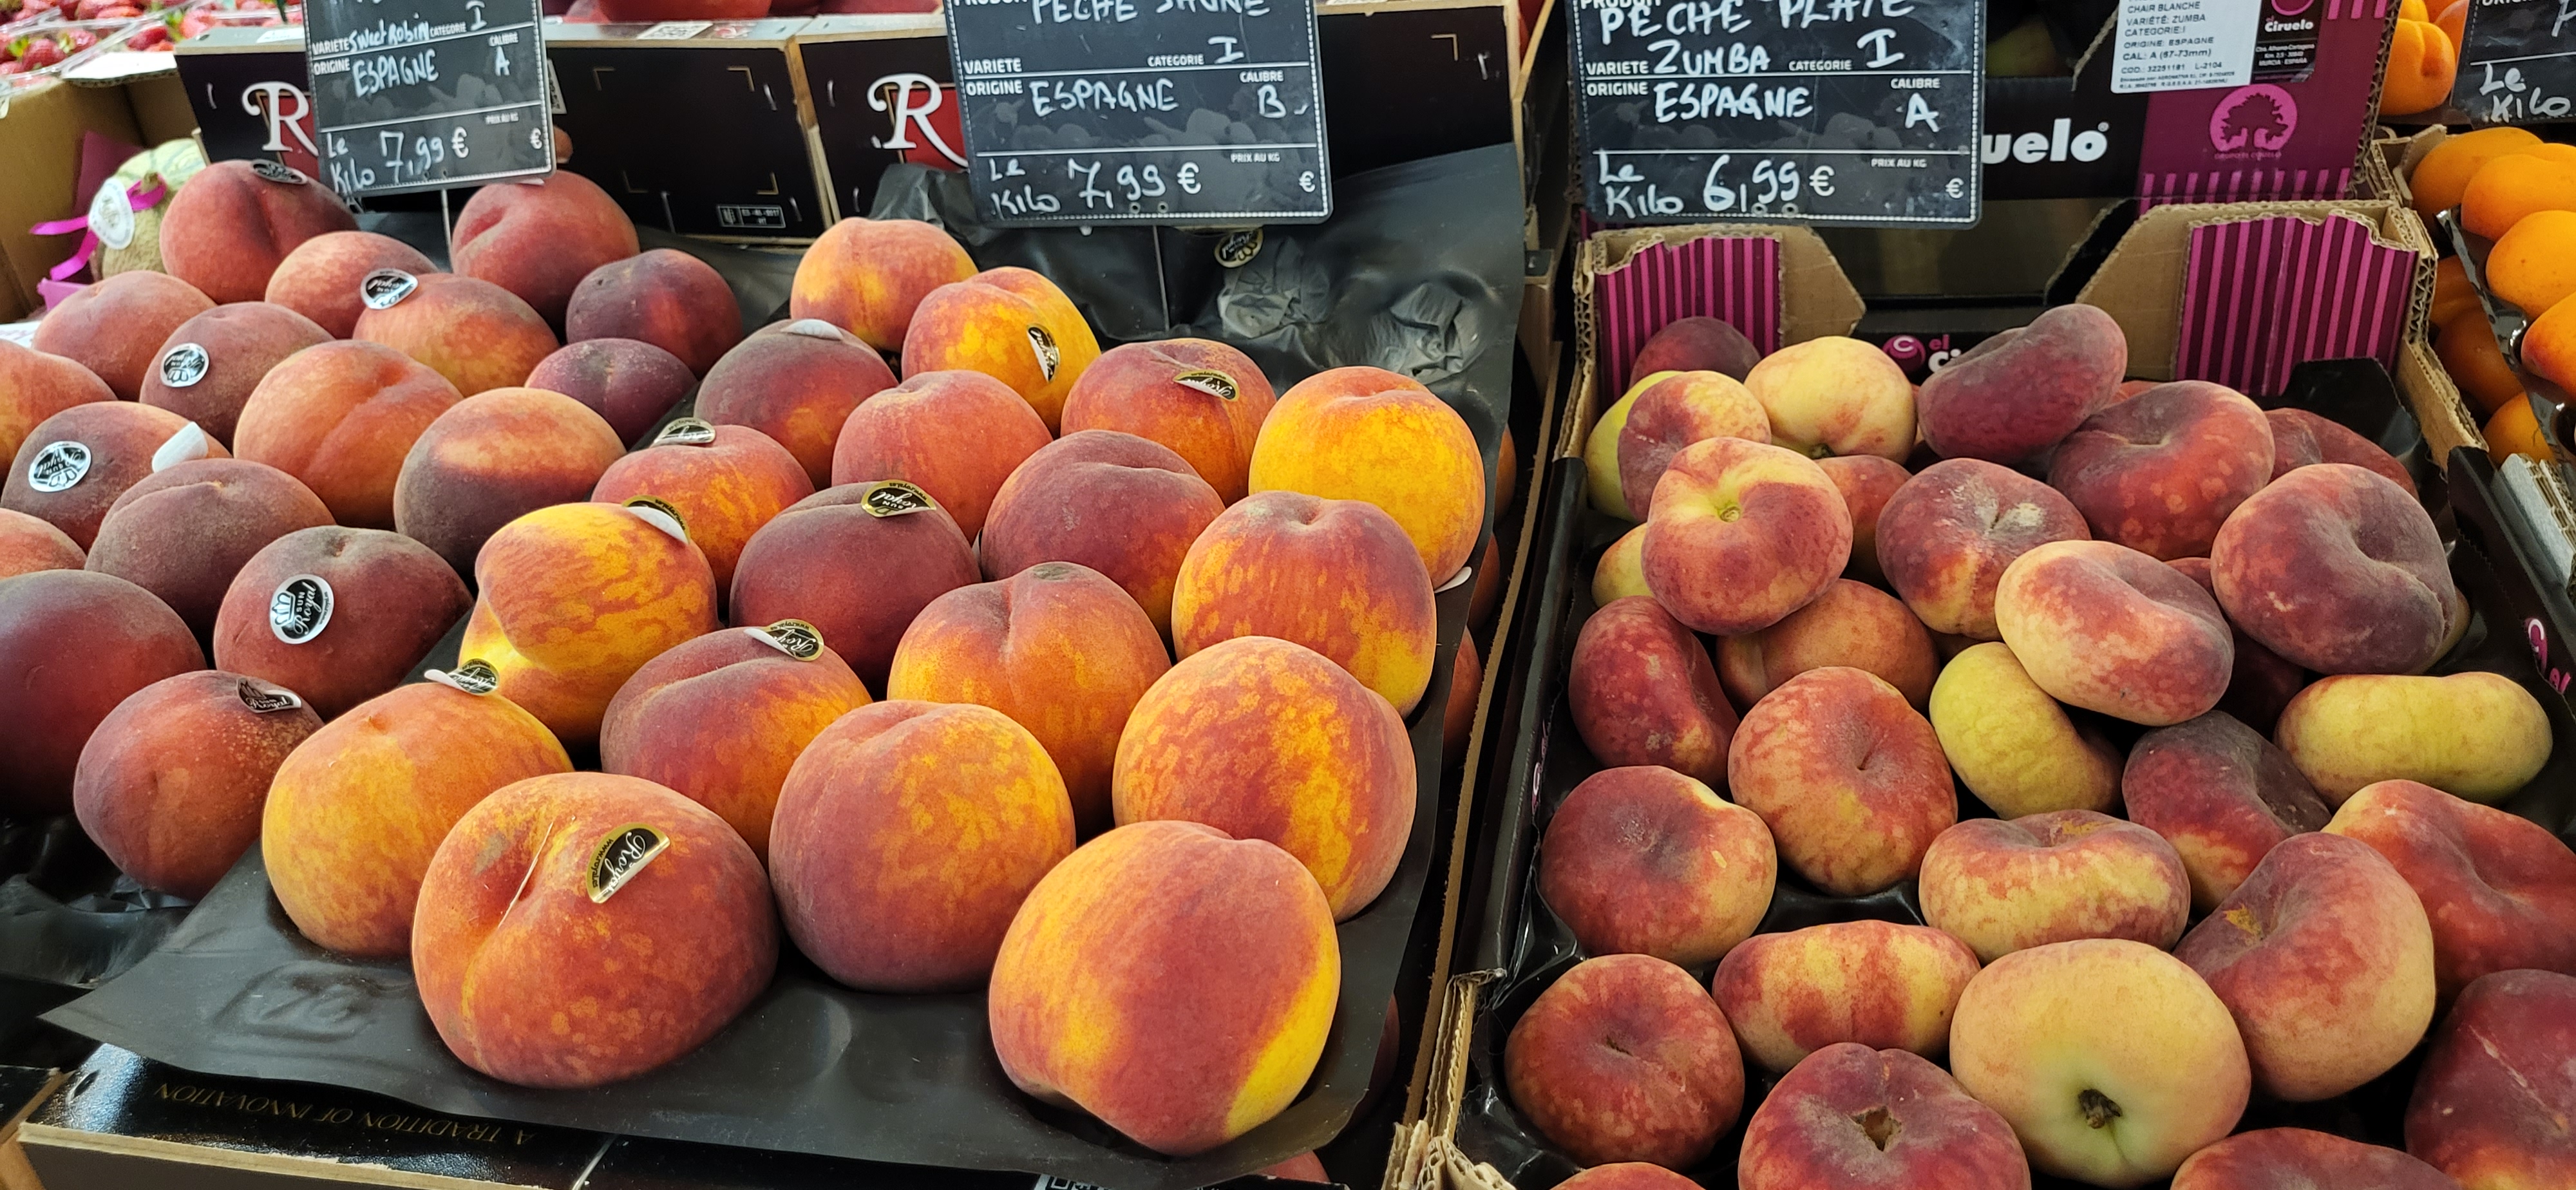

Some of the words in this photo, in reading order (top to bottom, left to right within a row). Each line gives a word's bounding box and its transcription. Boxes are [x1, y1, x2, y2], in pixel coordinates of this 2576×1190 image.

[2127, 5, 2155, 14] CHAIR
[2157, 1, 2201, 12] BLANCHE
[2172, 14, 2206, 24] ZUMBA
[312, 37, 350, 55] VARIETE
[430, 22, 467, 37] CATEGORIE
[489, 32, 519, 46] CALIBRE
[2264, 19, 2314, 32] Ciruelo
[965, 57, 1023, 75] VARIETE
[1147, 54, 1205, 66] CATEGORIE
[1208, 36, 1244, 64] I
[1586, 61, 1649, 75] VARIETE
[1647, 39, 1770, 76] ZUMBA
[1788, 60, 1853, 71] CATEGORIE
[1857, 28, 1905, 68] I
[2168, 37, 2214, 46] ESPAGNE
[313, 58, 350, 75] ORIGINE
[352, 48, 439, 98] ESPAGNE
[495, 46, 511, 77] A
[1240, 70, 1284, 84] CALIBRE
[1890, 77, 1940, 90] CALIBRE
[2479, 62, 2526, 95] Le
[965, 79, 1025, 97] ORIGINE
[1030, 79, 1179, 117] ESPAGNE
[1586, 81, 1649, 97] ORIGINE
[1654, 80, 1815, 122] ESPAGNE
[1904, 93, 1940, 133] A
[242, 81, 319, 157] R
[867, 73, 969, 168] R
[327, 132, 349, 158] Le
[529, 128, 543, 150] €
[380, 129, 446, 185] 7,99
[451, 126, 469, 159] €
[989, 158, 1027, 182] Le
[1231, 153, 1253, 164] PRIX
[1253, 153, 1267, 163] AU
[1598, 148, 1645, 184] Le
[1871, 158, 1896, 169] PRIX
[1897, 158, 1911, 168] AU
[1912, 158, 1927, 168] KG
[1066, 158, 1167, 211] 7,99
[1177, 162, 1202, 194] €
[1298, 171, 1316, 193] €
[1702, 155, 1801, 212] 6,99
[1809, 165, 1835, 196] €
[1946, 178, 1964, 199] €
[1605, 184, 1685, 218] Kilo
[294, 581, 321, 635] Royal
[296, 592, 306, 613] SUN
[155, 1082, 312, 1119] INNOVATION
[316, 1108, 354, 1123] OF
[362, 1111, 503, 1143] TRADITION
